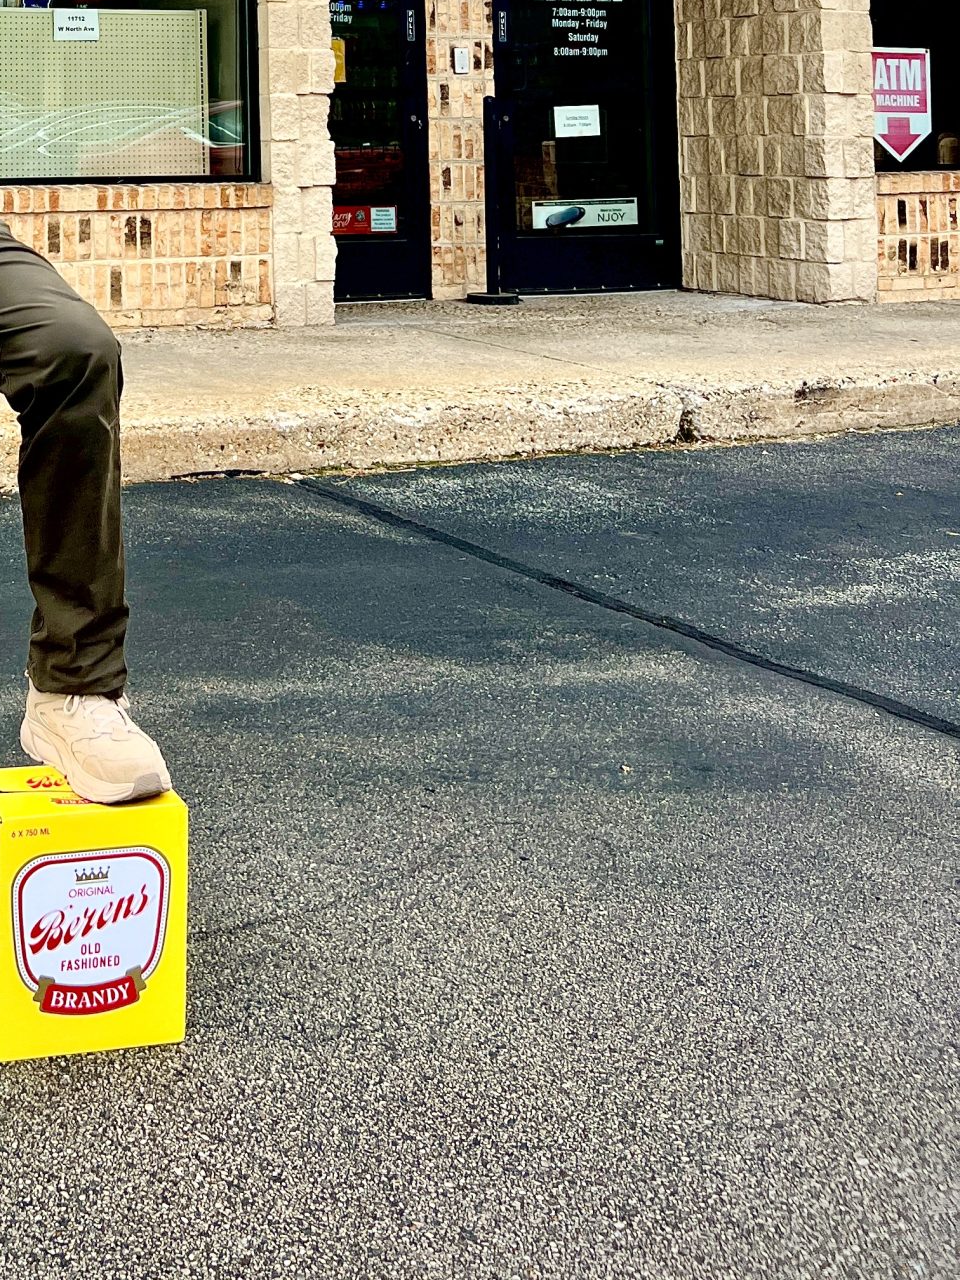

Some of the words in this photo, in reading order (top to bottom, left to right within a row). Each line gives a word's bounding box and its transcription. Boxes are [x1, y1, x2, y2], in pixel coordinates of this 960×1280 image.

[551, 18, 580, 29] Monday
[585, 19, 608, 29] Friday
[568, 32, 599, 43] Saturday
[874, 58, 921, 91] ATM
[875, 94, 920, 107] MACHINE
[597, 212, 626, 223] NJOY
[25, 828, 38, 837] 750
[40, 827, 50, 835] ML
[68, 885, 116, 899] ORIGINAL
[28, 883, 149, 955] Berens
[80, 942, 101, 956] OLD
[60, 955, 121, 972] FASHIONED
[50, 981, 131, 1009] BRANDY
